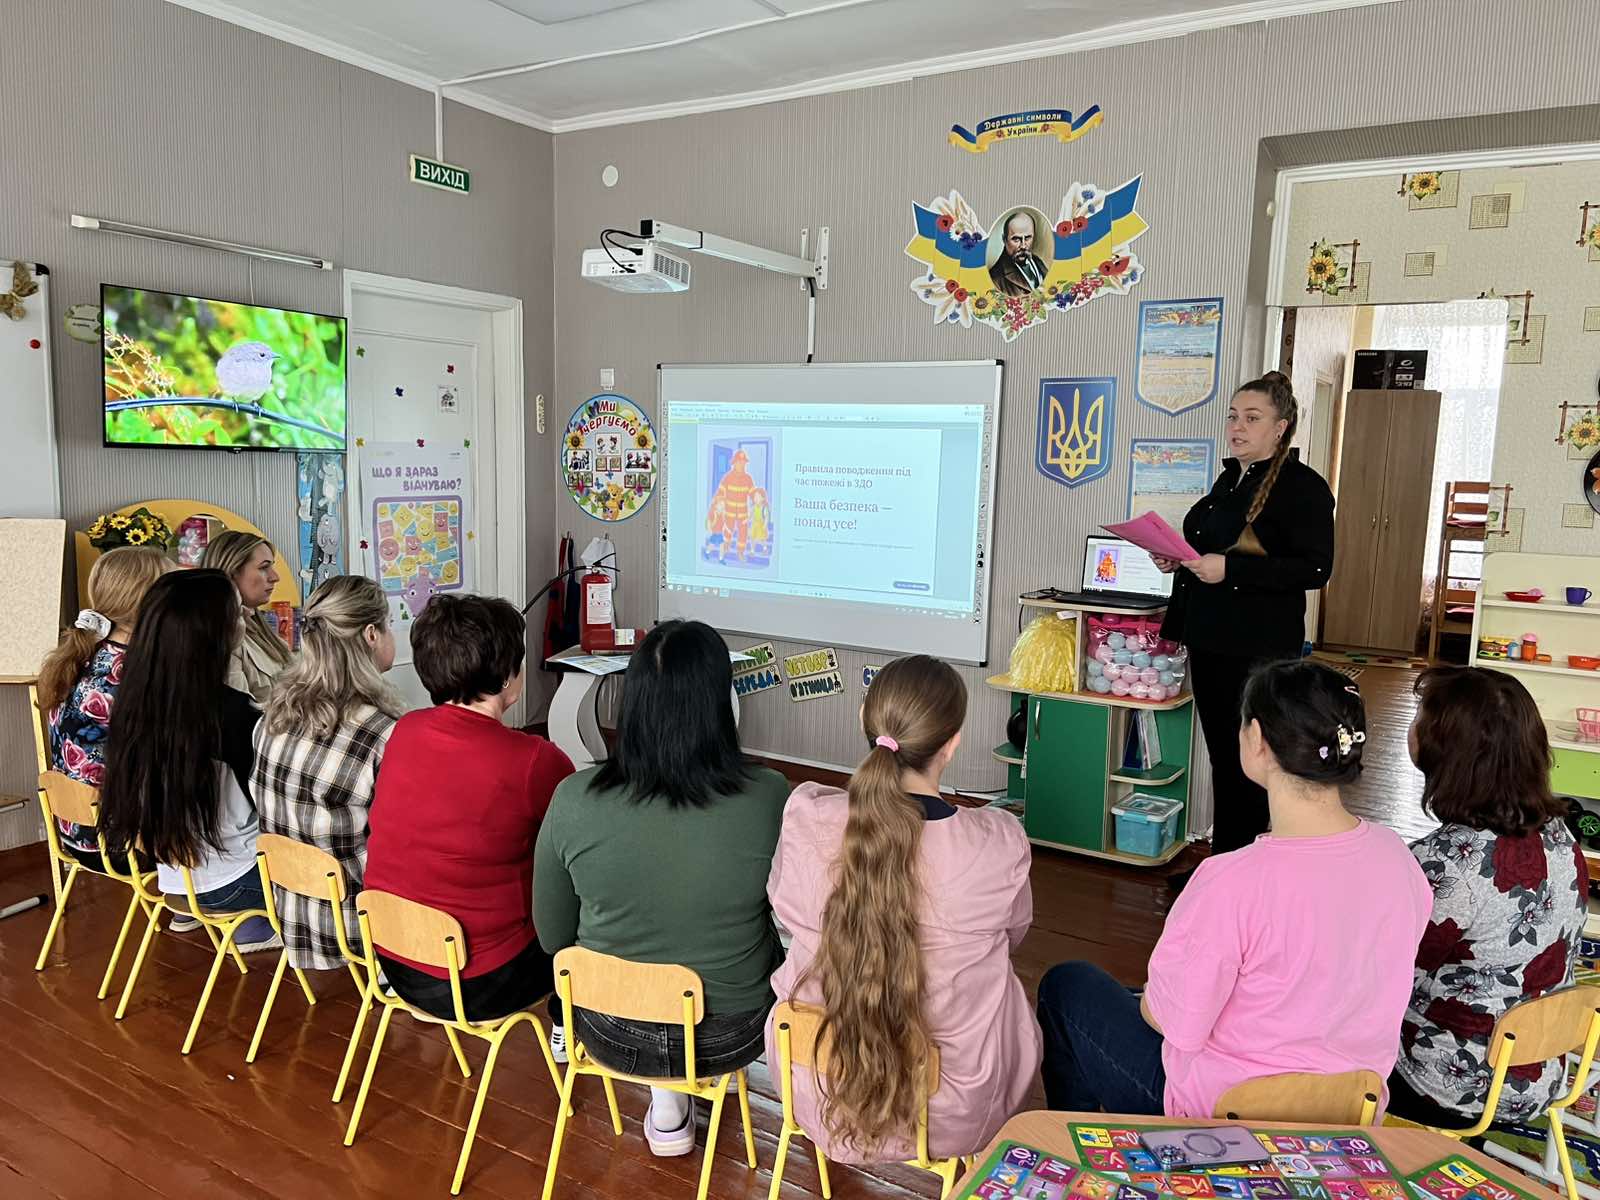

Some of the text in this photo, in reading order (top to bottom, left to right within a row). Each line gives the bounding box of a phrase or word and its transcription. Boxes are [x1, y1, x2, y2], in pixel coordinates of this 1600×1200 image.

[984, 113, 1061, 130] Державні символи
[1007, 125, 1038, 137] України
[420, 162, 465, 189] ВИХІД
[599, 401, 616, 412] Ми
[583, 415, 637, 437] чергуємо
[372, 466, 439, 478] ЩО Я ЗАРАЗ
[795, 463, 912, 477] Правила поводження під
[403, 478, 462, 492] ВІДЧУВАЮ?
[794, 478, 809, 487] час
[811, 478, 846, 488] пожежі
[854, 479, 873, 490] ЗДО
[794, 498, 827, 511] Ваша
[829, 499, 880, 513] безпека
[794, 518, 857, 532] понад усе!
[1349, 1138, 1370, 1151] Ф
[1011, 1147, 1032, 1159] Ф
[1046, 1159, 1071, 1176] М
[1292, 1159, 1311, 1171] О
[1362, 1159, 1389, 1174] М
[1192, 1177, 1210, 1194] Й
